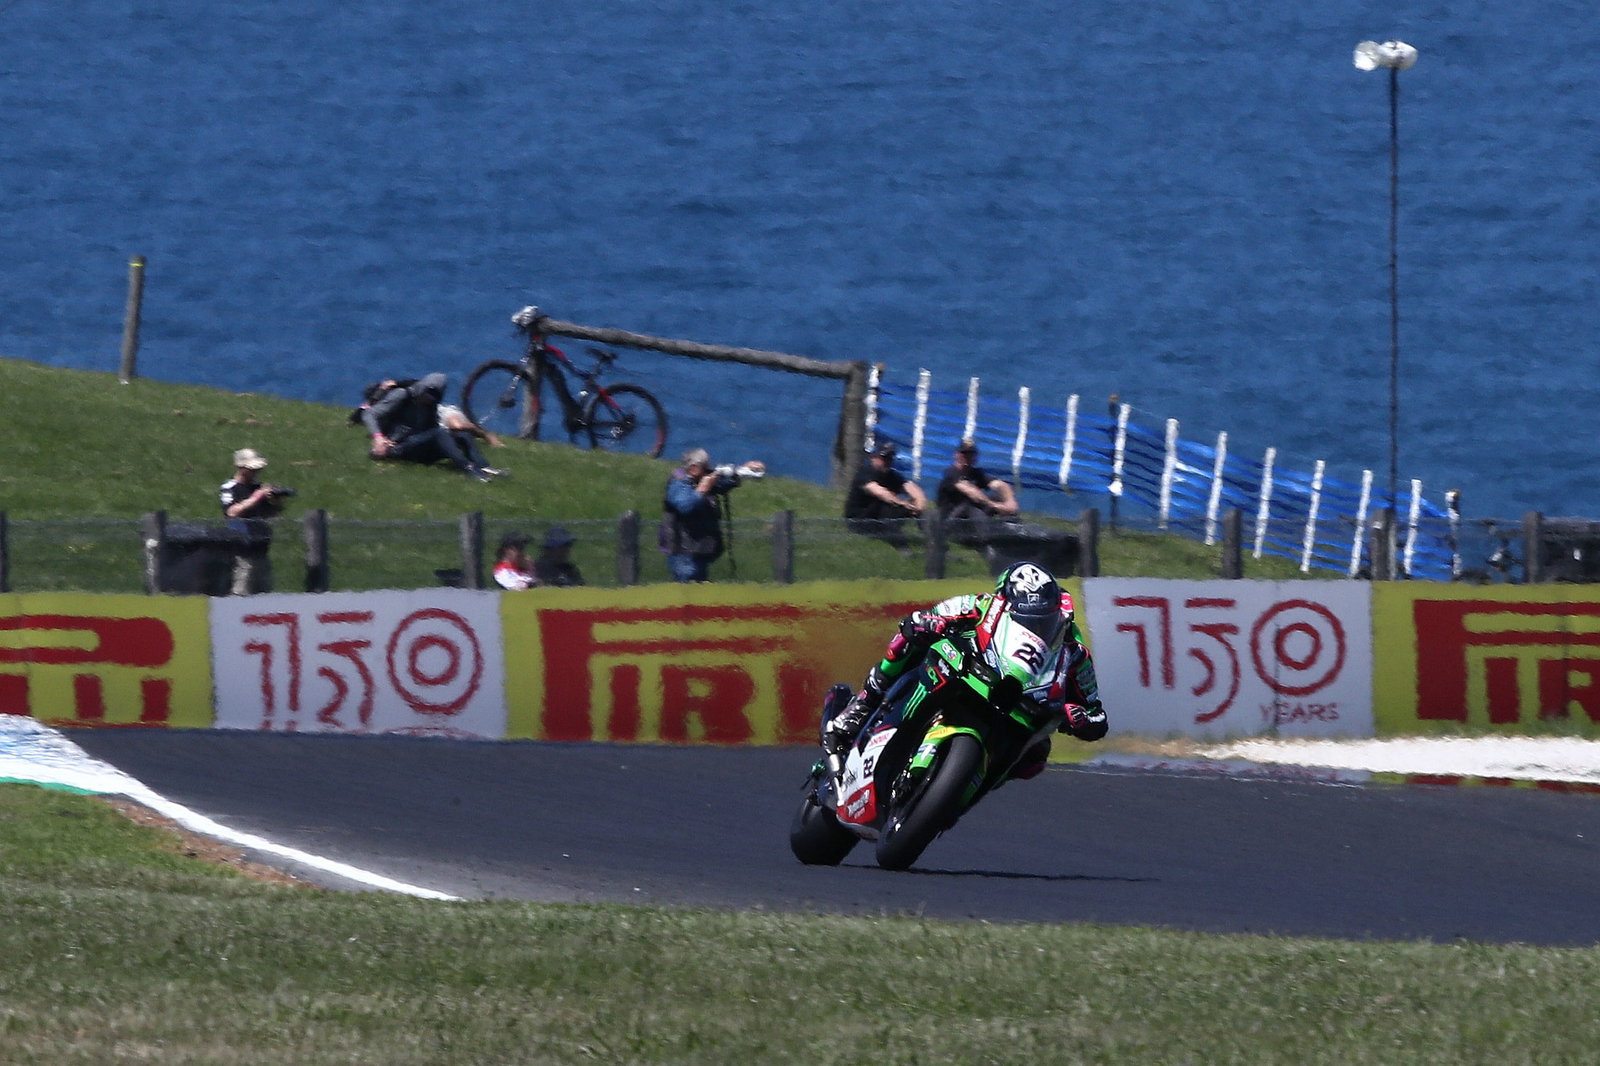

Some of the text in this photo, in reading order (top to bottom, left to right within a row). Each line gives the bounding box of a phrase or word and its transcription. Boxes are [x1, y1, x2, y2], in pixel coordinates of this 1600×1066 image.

[1012, 642, 1044, 675] 22
[1113, 596, 1346, 723] 150
[1259, 702, 1340, 724] YEARS
